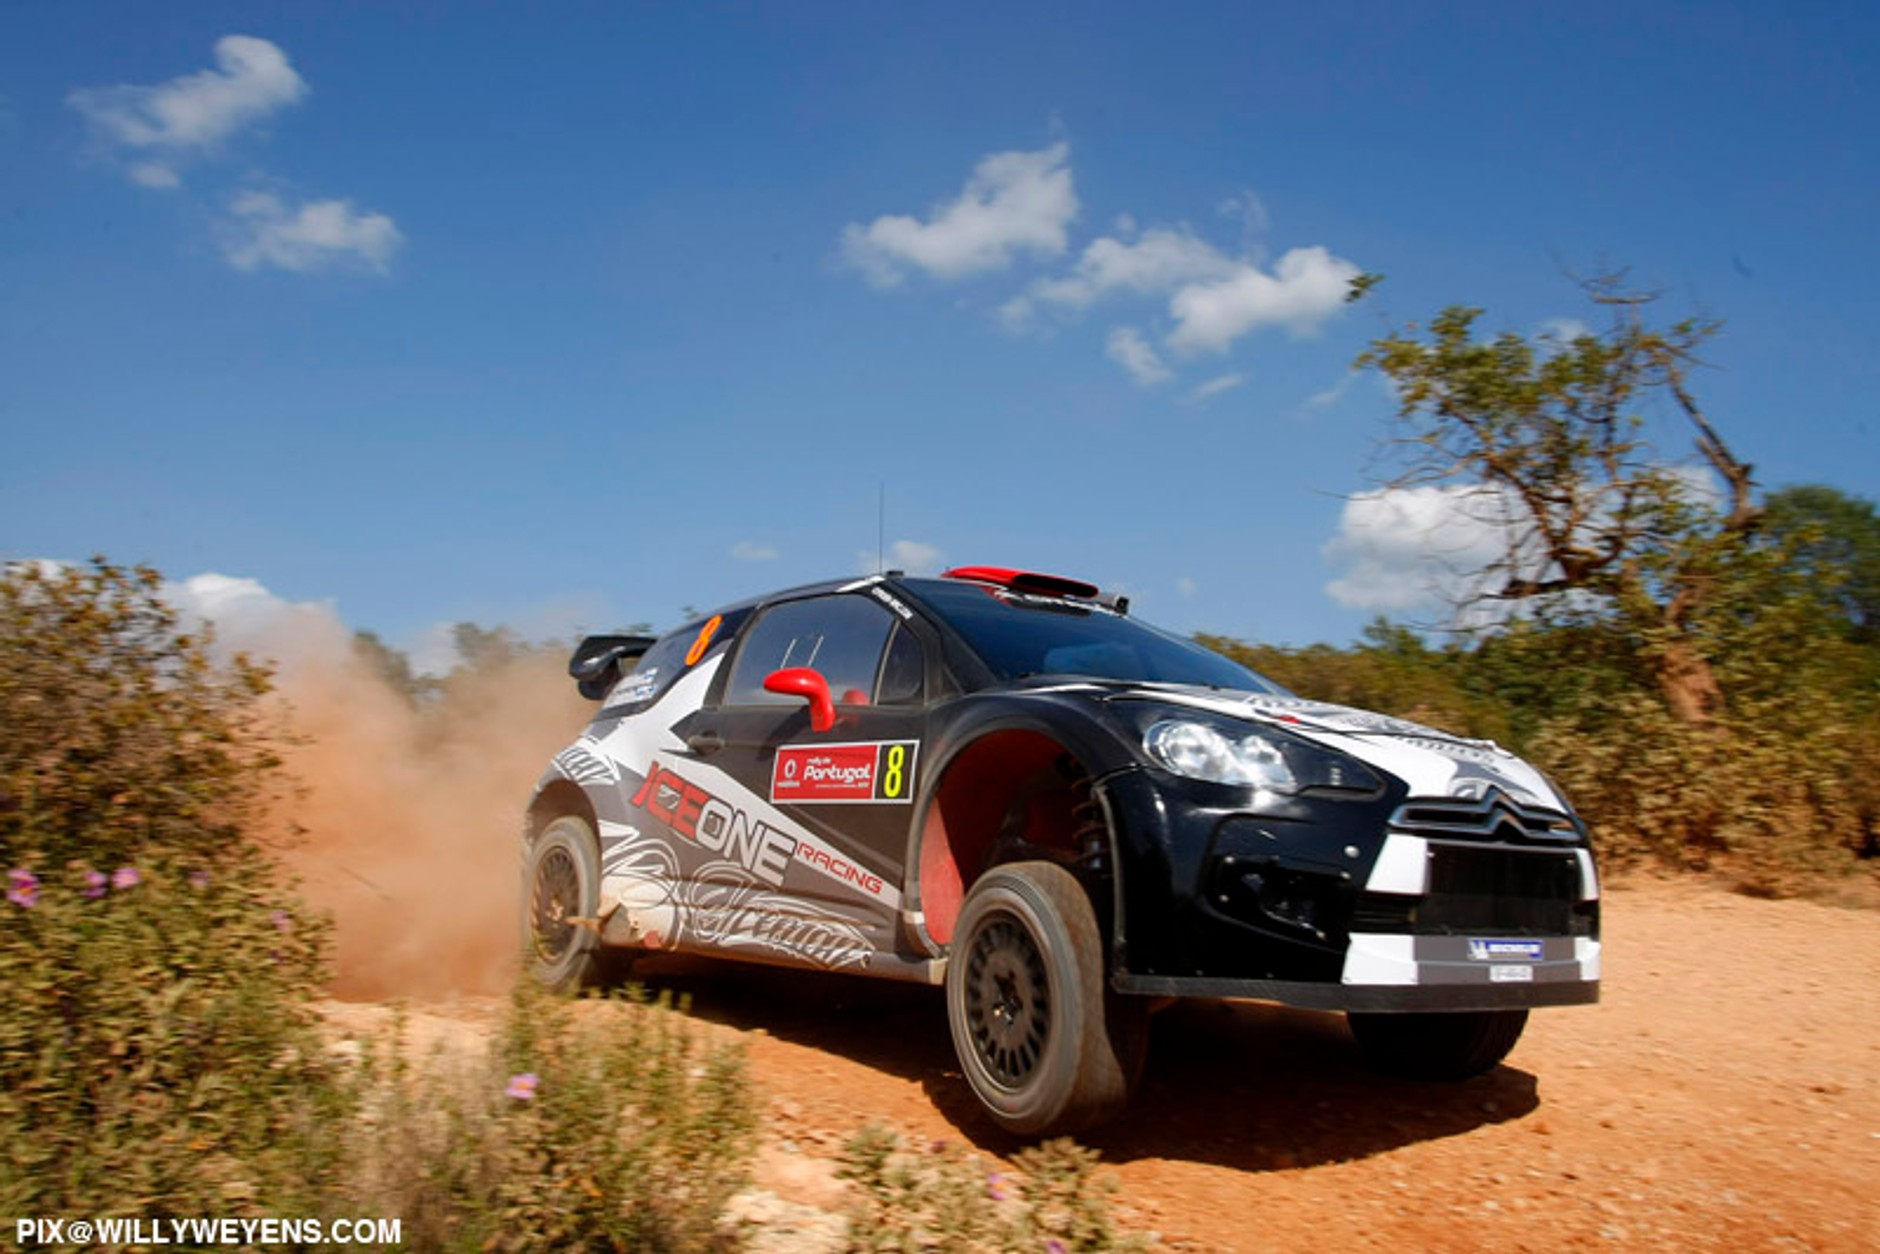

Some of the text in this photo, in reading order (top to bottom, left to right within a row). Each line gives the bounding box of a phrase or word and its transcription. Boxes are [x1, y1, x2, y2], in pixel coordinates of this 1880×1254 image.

[685, 614, 722, 666] 8
[803, 764, 870, 783] Portugal
[884, 745, 904, 797] 8
[796, 842, 883, 895] RACING
